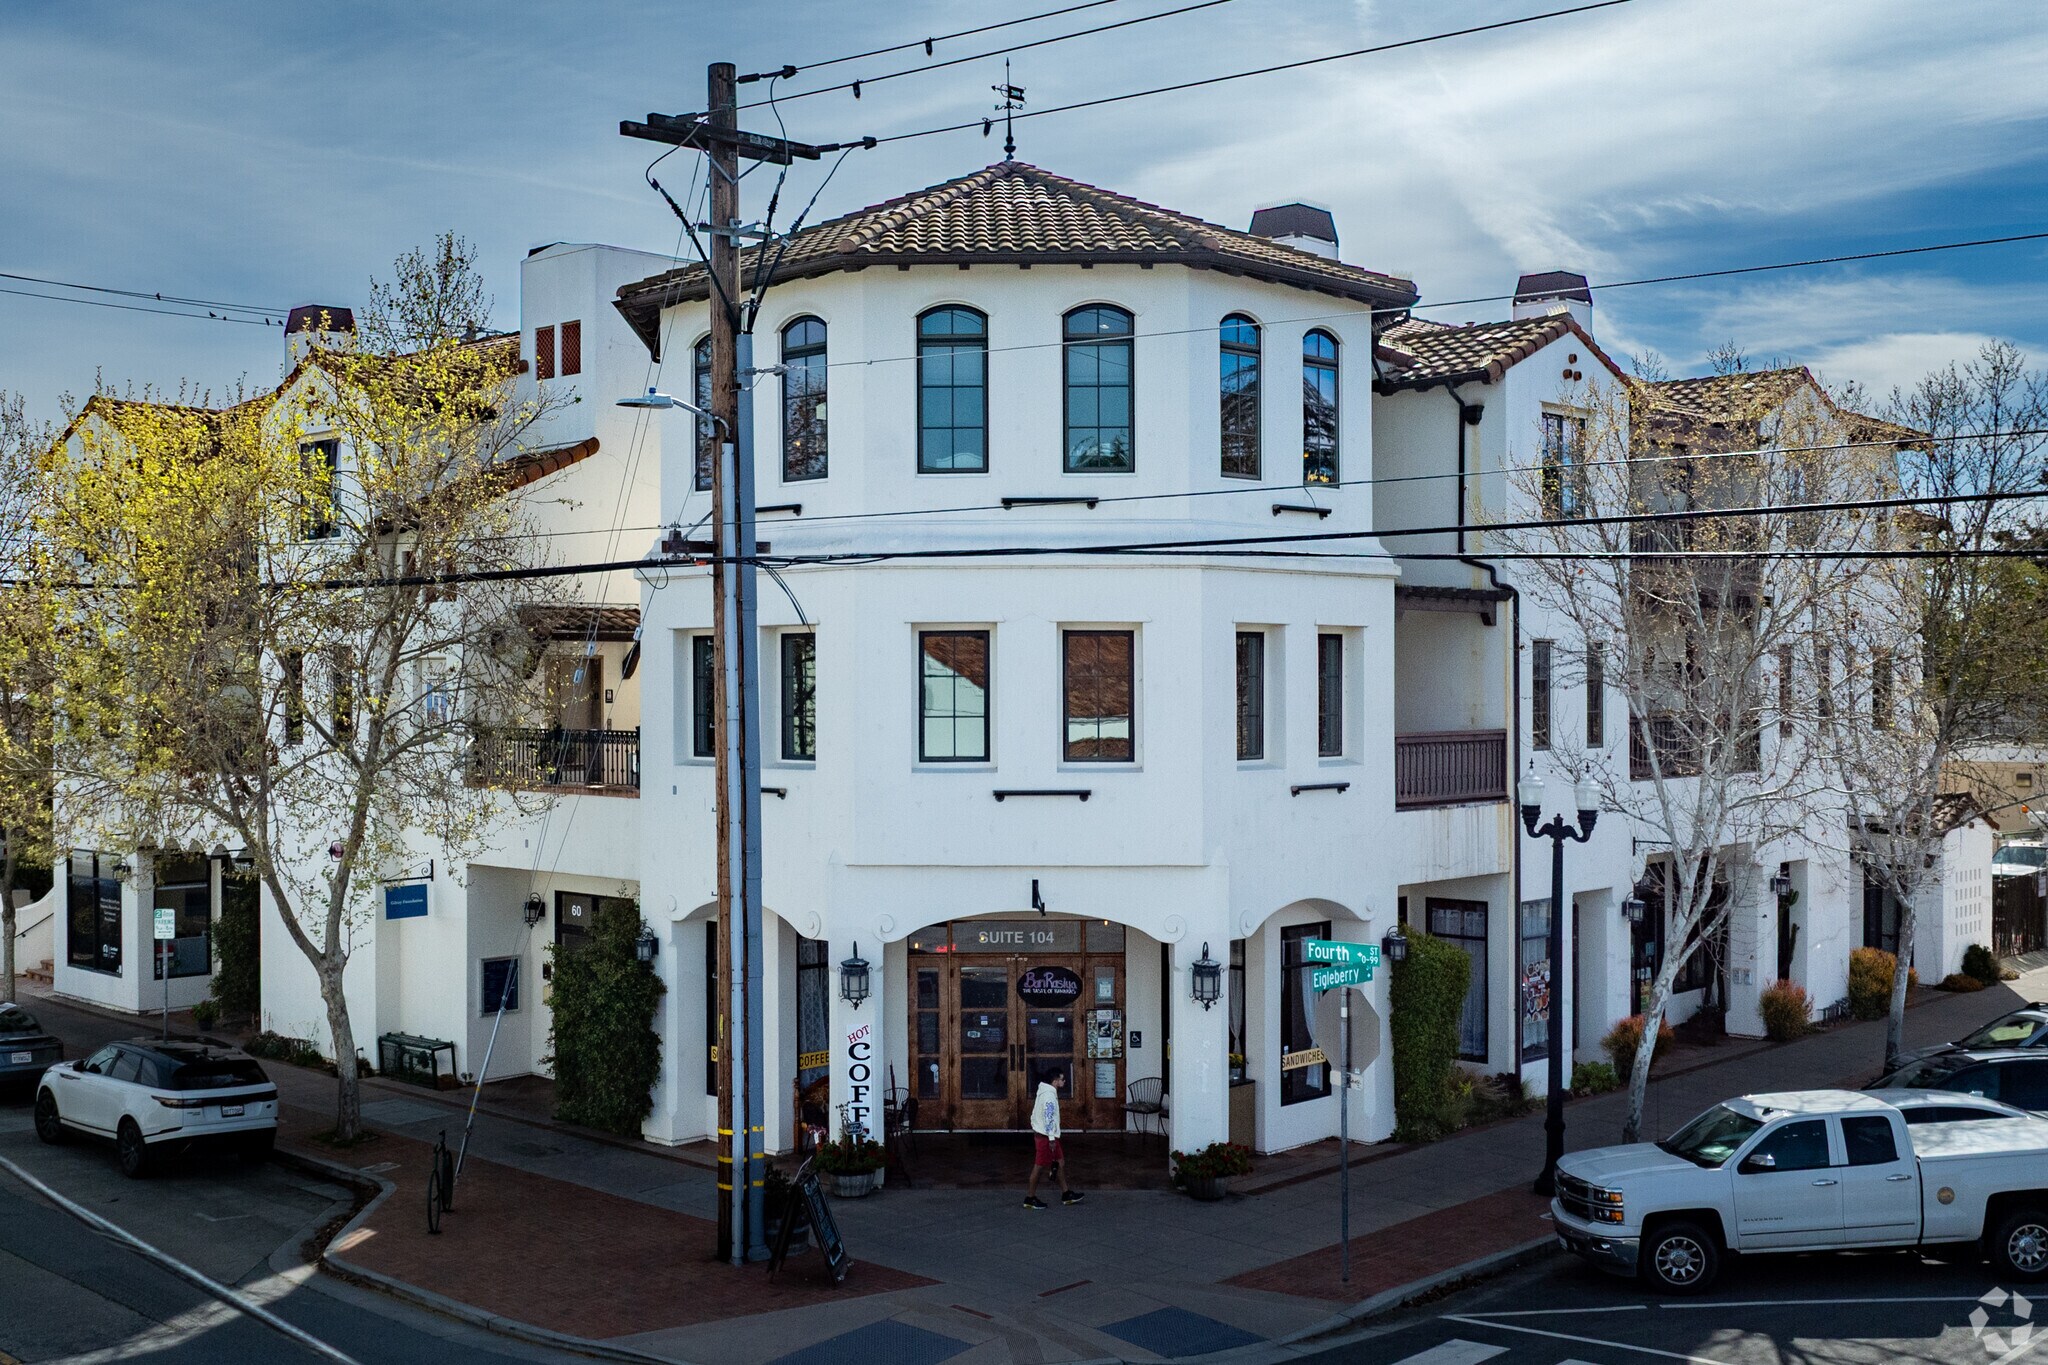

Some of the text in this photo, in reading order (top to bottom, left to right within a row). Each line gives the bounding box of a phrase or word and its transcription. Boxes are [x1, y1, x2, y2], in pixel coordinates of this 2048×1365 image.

[571, 904, 582, 917] 60
[978, 931, 1055, 944] SUITE 104
[1308, 942, 1350, 962] Fourth
[1370, 947, 1379, 956] ST
[1361, 955, 1379, 964] 0-99
[1313, 968, 1360, 990] Eigleberry
[847, 1024, 870, 1044] HOT
[799, 1052, 829, 1067] COFFEE
[1282, 1051, 1324, 1067] SANDWICHES
